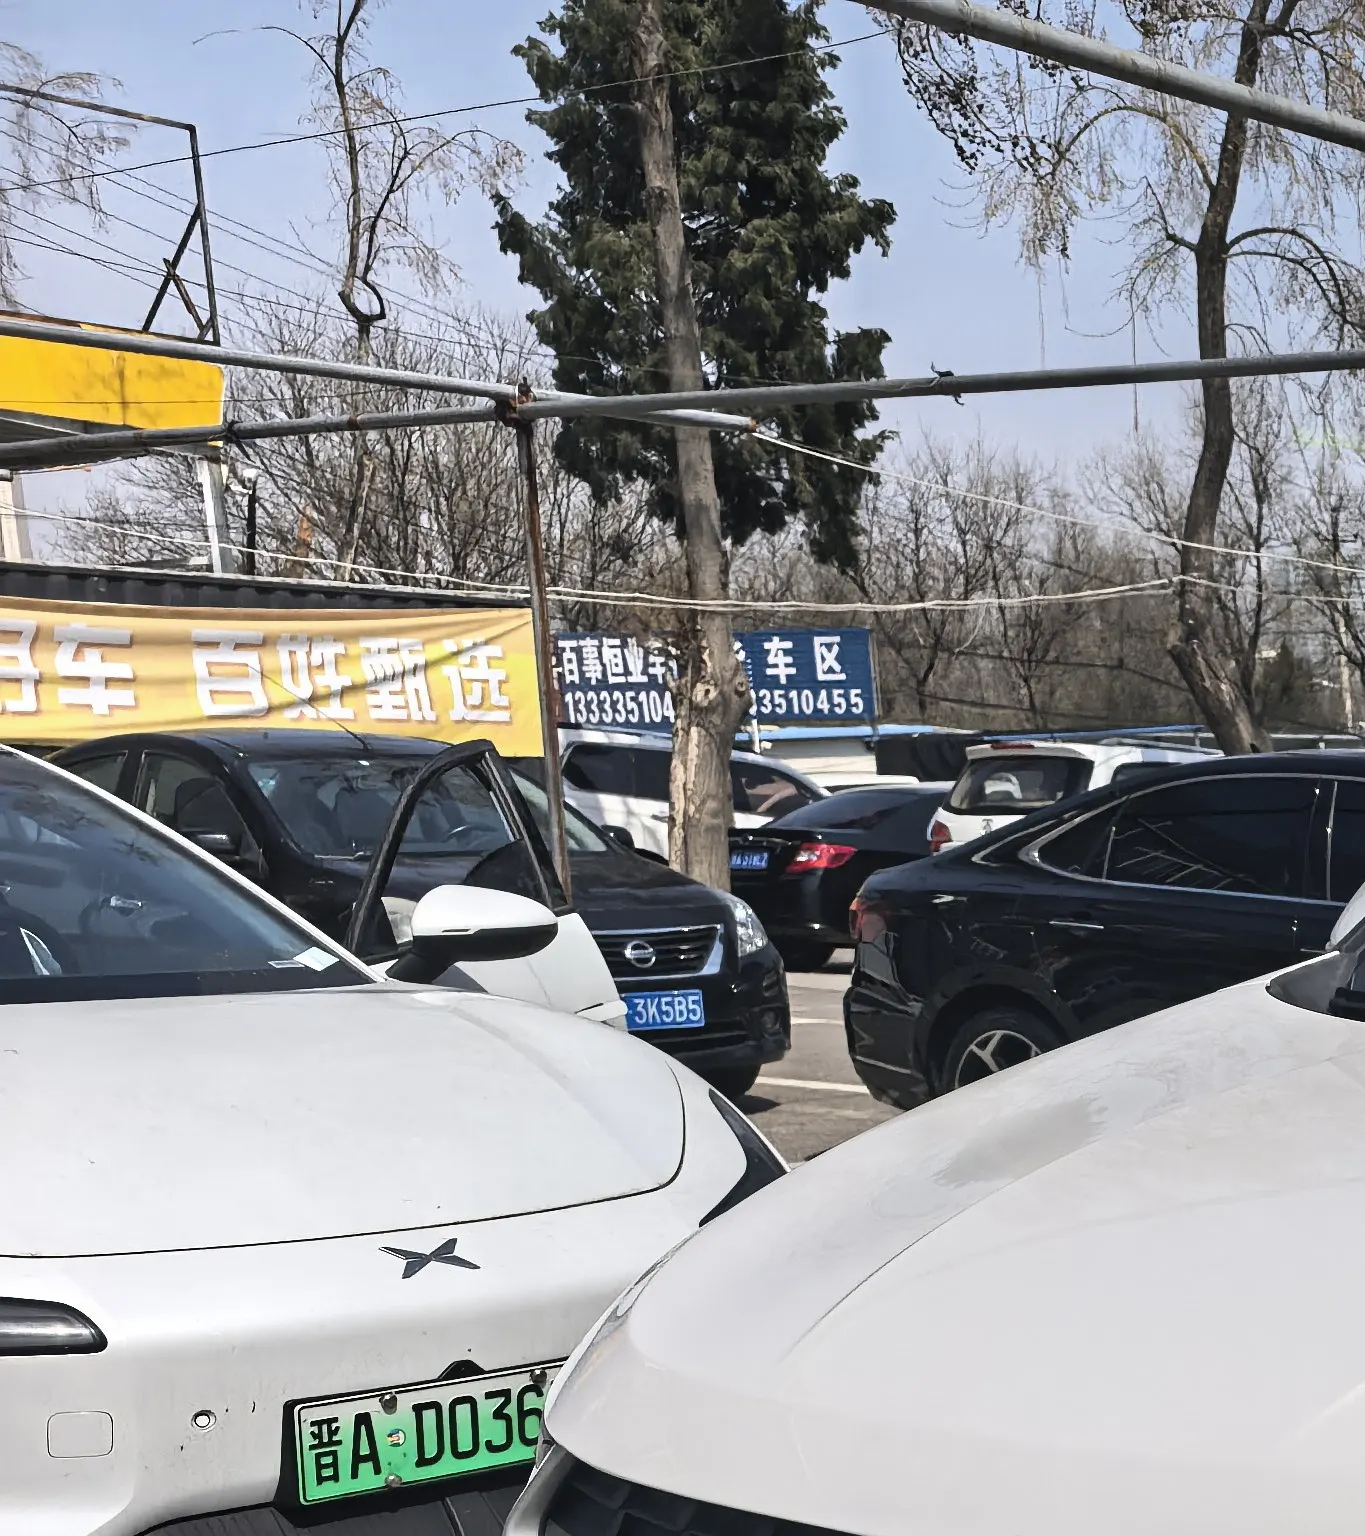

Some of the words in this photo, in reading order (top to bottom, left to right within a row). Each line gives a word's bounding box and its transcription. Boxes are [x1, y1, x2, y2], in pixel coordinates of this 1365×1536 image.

[191, 629, 512, 722] 百姓甄选
[552, 636, 678, 685] 百事恒业车
[733, 636, 847, 685] 车区
[564, 690, 676, 724] 133335104
